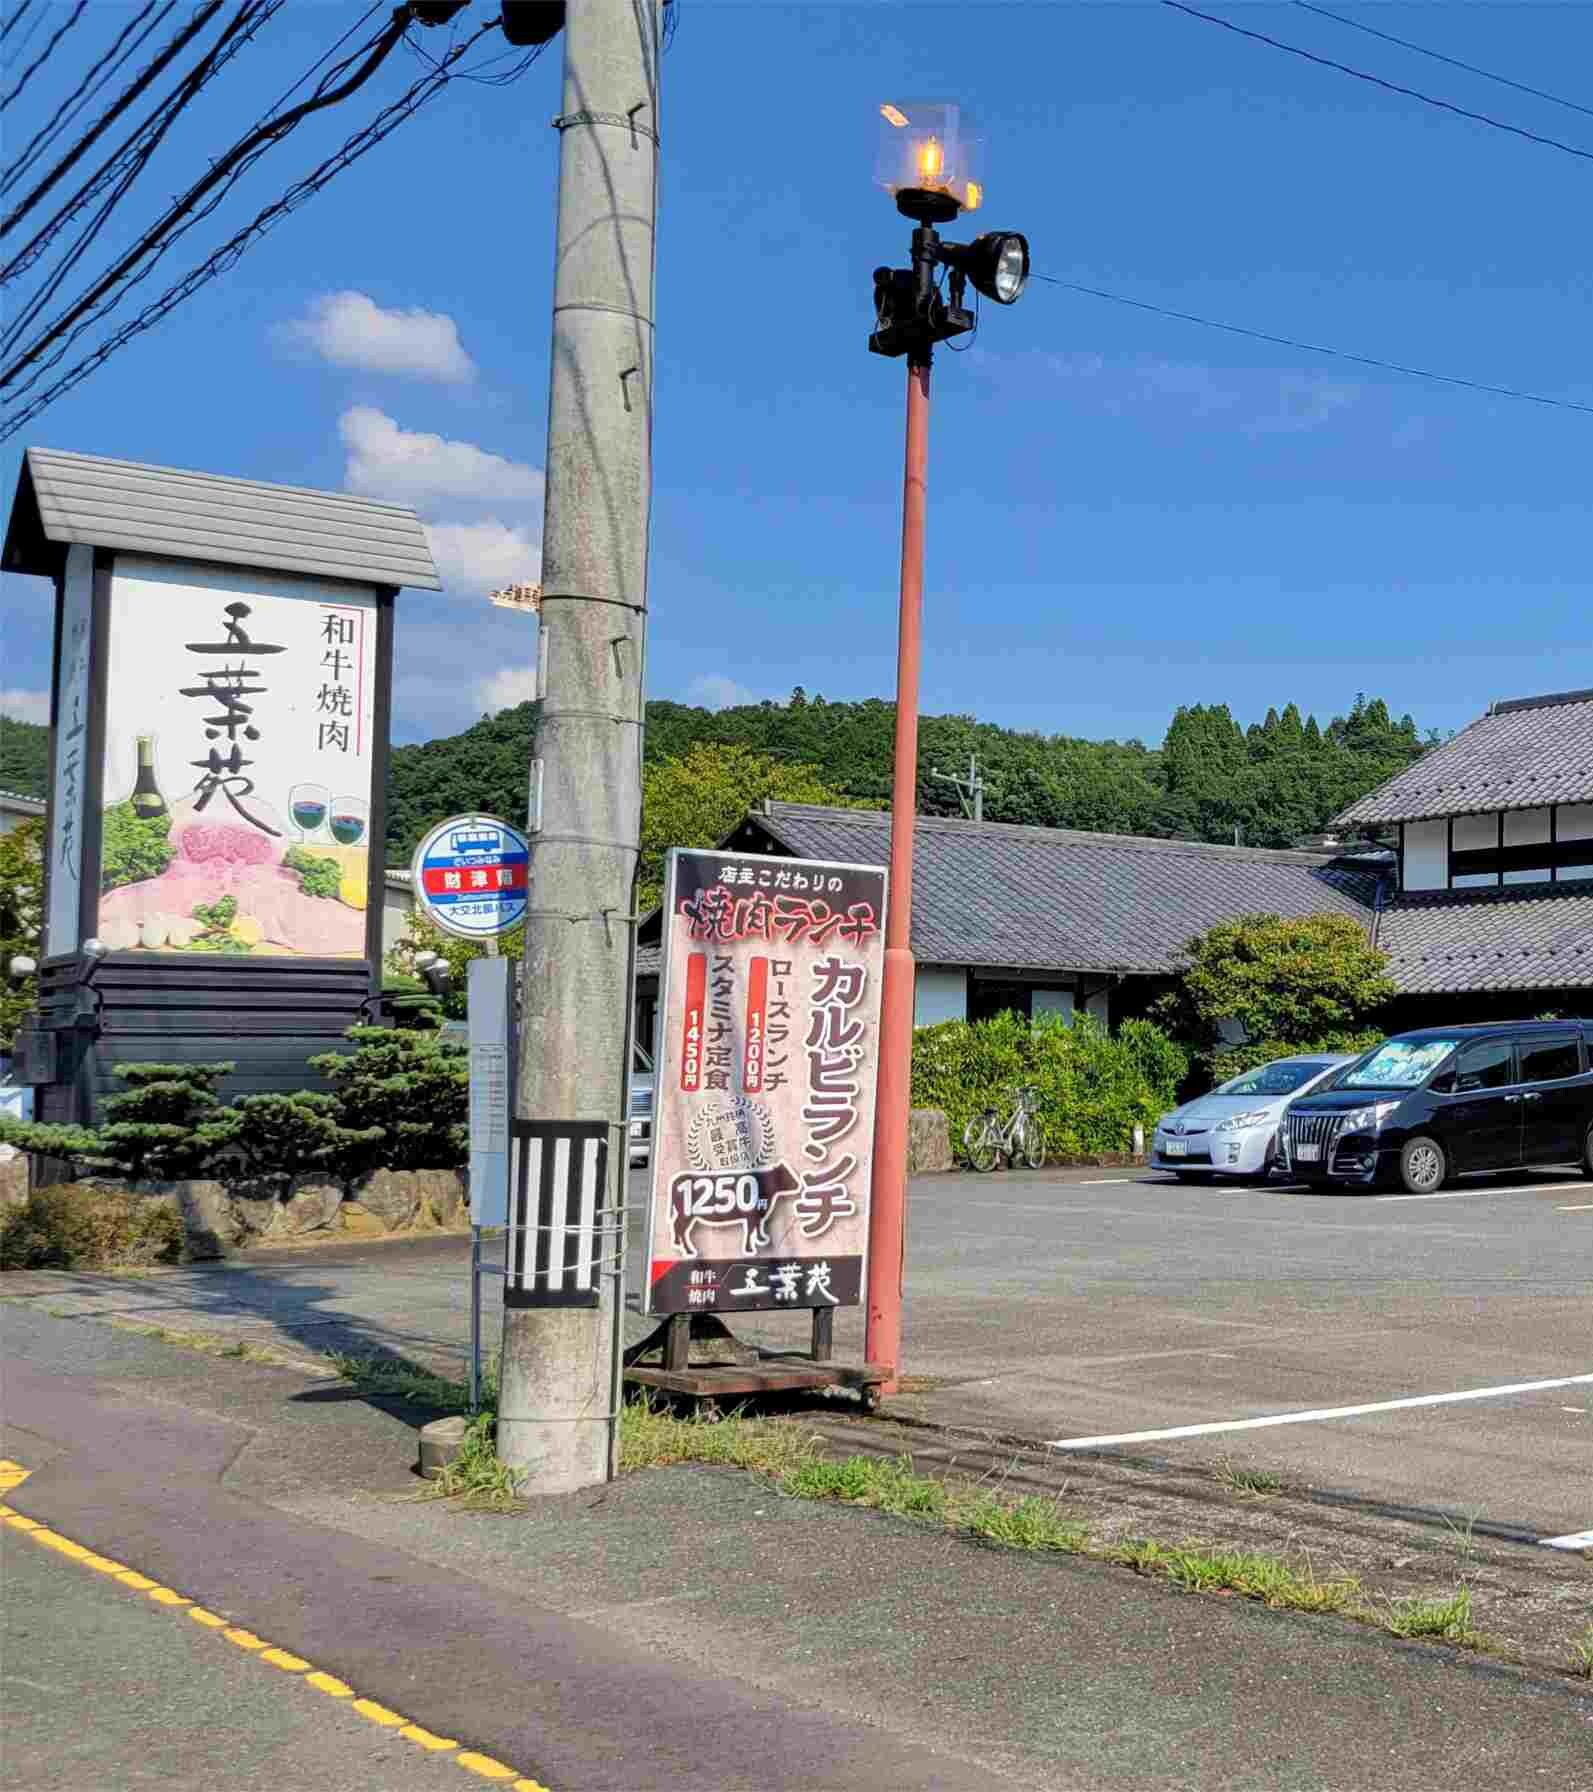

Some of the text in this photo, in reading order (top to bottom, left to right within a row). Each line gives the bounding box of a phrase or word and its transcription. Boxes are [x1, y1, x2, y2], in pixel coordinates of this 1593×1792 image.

[179, 602, 288, 838] 五葉苑
[317, 614, 354, 753] 和牛焼肉
[680, 886, 877, 947] 焼肉ランチ
[718, 866, 843, 892] 店主こだわりの
[684, 1009, 699, 1087] 1450円
[703, 955, 735, 1090] スタミナ定食
[746, 1011, 761, 1087] 1200円
[764, 959, 792, 1091] ロースランチ
[795, 957, 864, 1237] カルビランチ
[729, 1261, 840, 1304] 五葉苑
